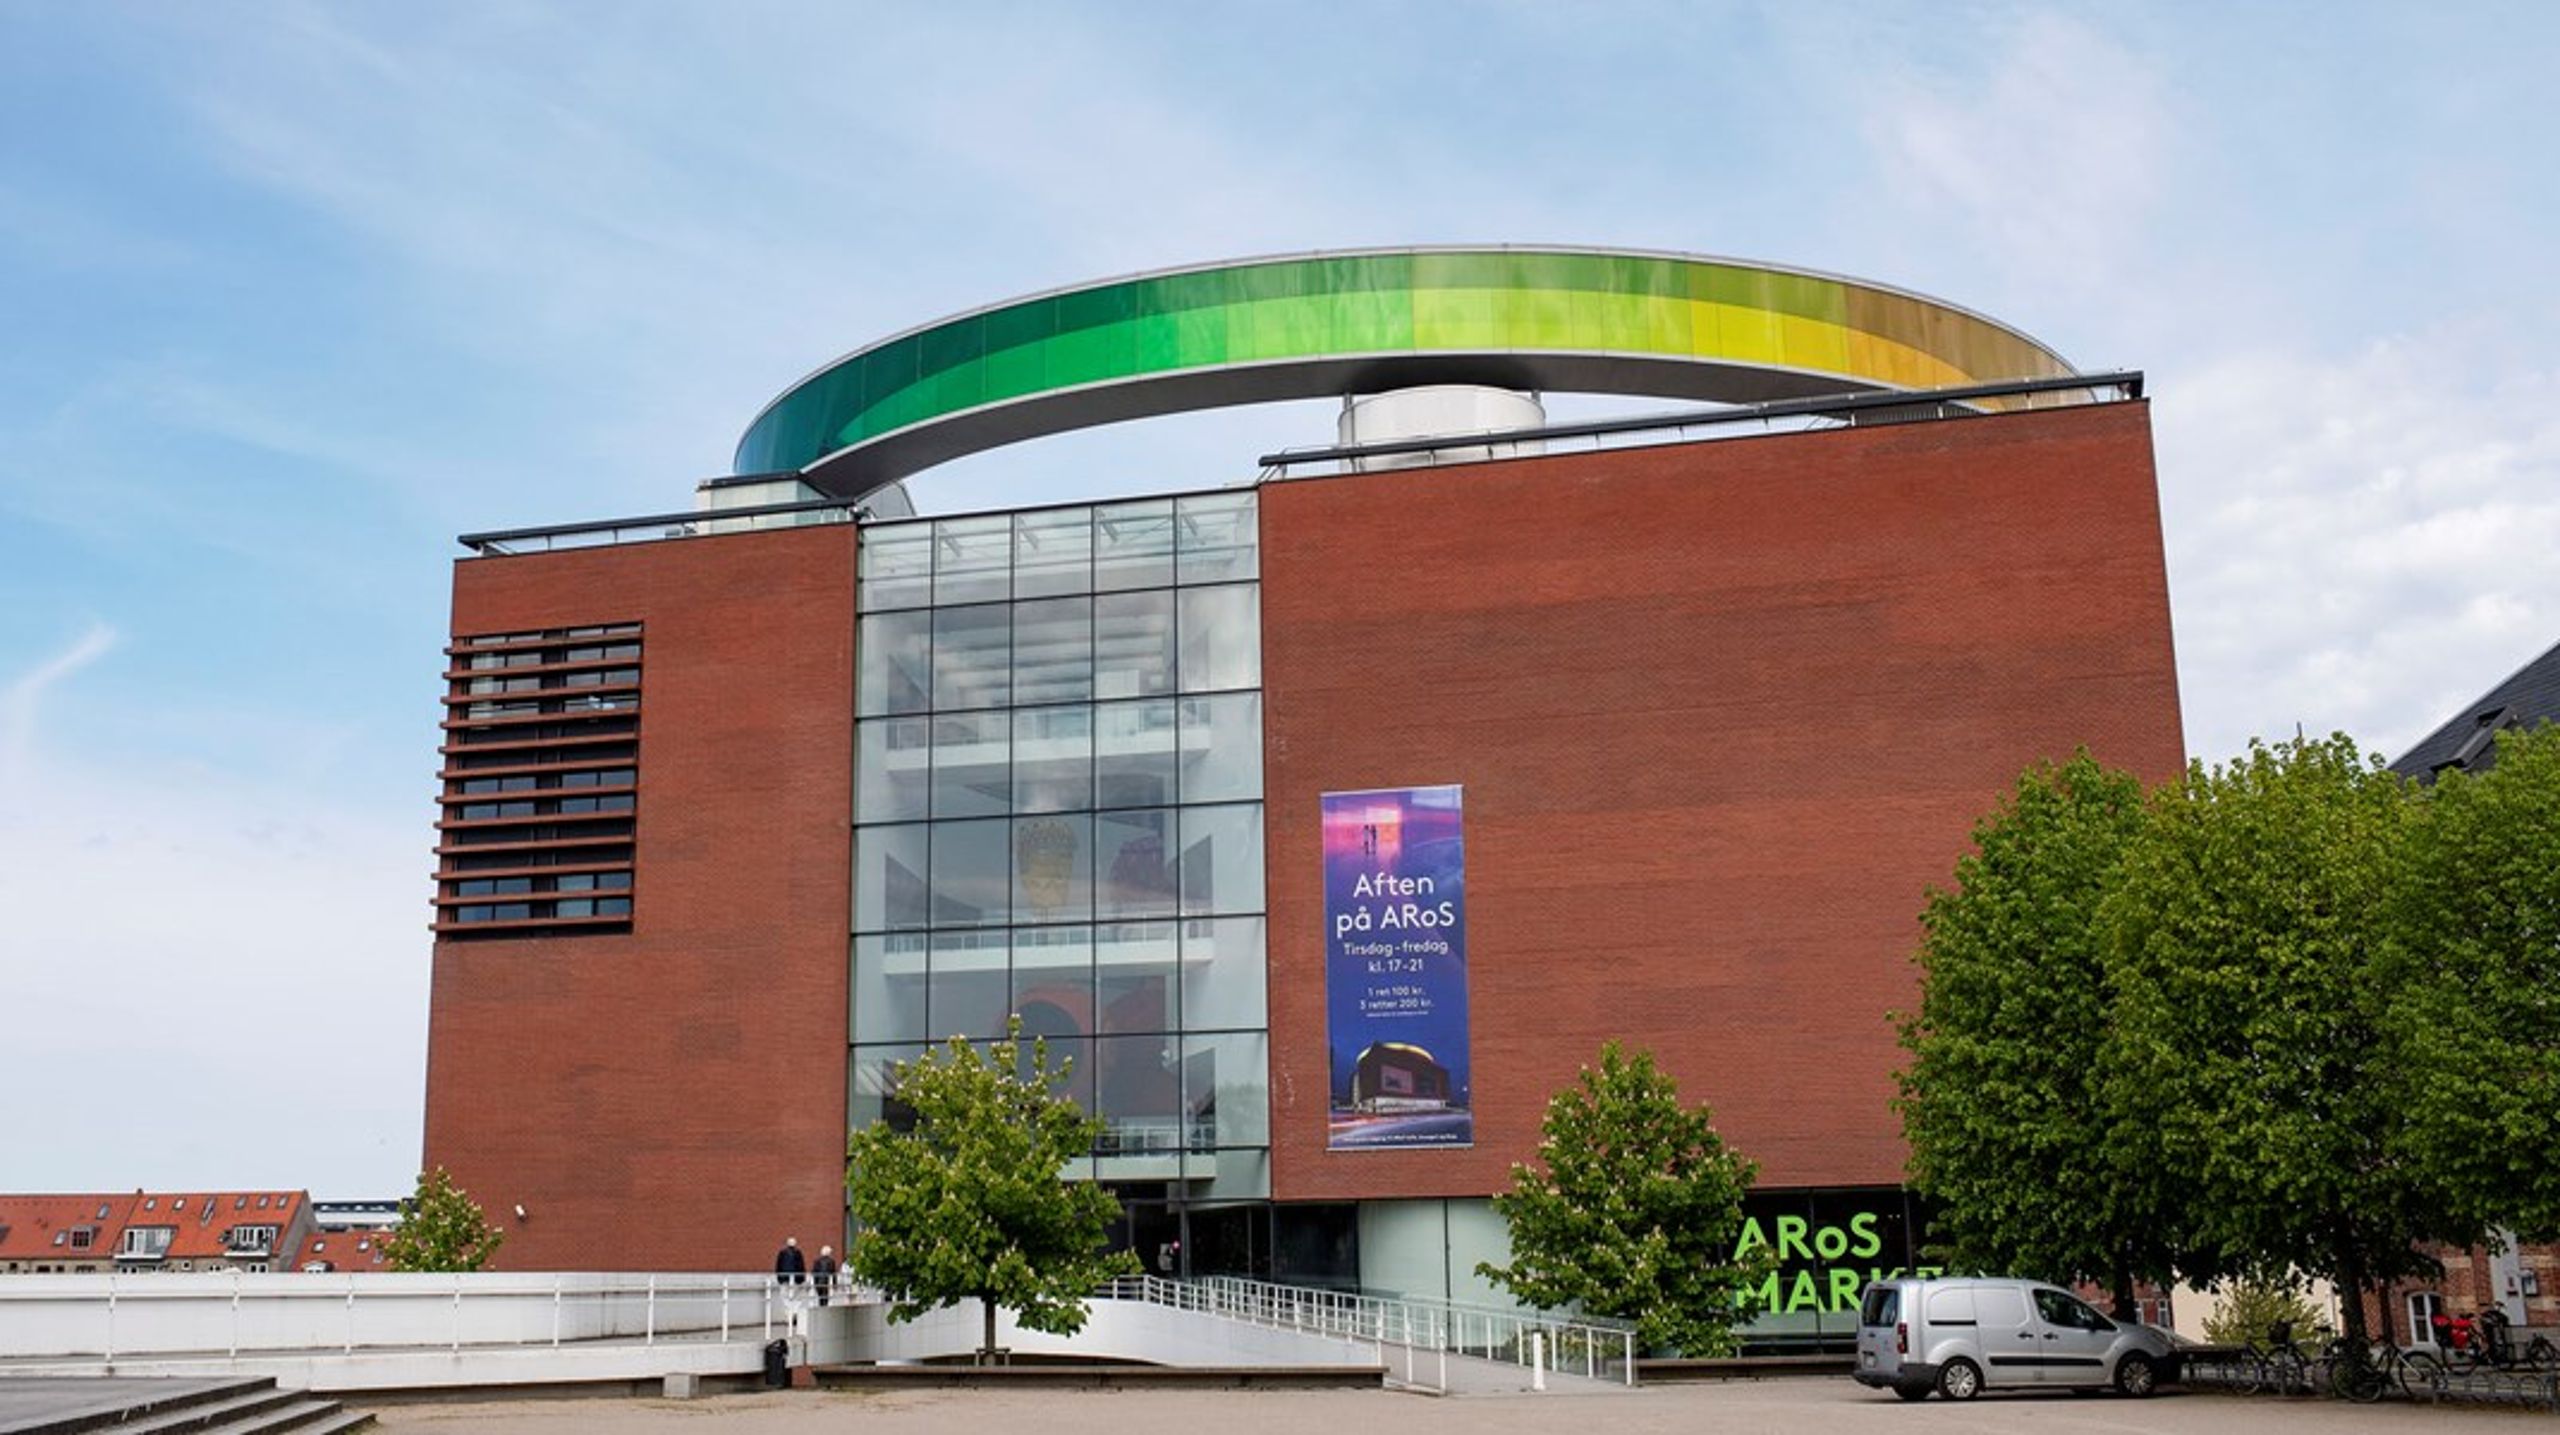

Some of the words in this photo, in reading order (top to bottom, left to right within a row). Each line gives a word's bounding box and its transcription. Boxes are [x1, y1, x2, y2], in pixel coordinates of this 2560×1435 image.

[1353, 872, 1434, 898] Aften
[1337, 906, 1372, 939] på
[1380, 901, 1455, 929] ARoS
[1368, 960, 1386, 972] kl.
[1392, 986, 1410, 996] 100
[1411, 986, 1427, 996] kr.
[1420, 997, 1435, 1007] kr.
[1733, 1211, 1881, 1261] ARoS
